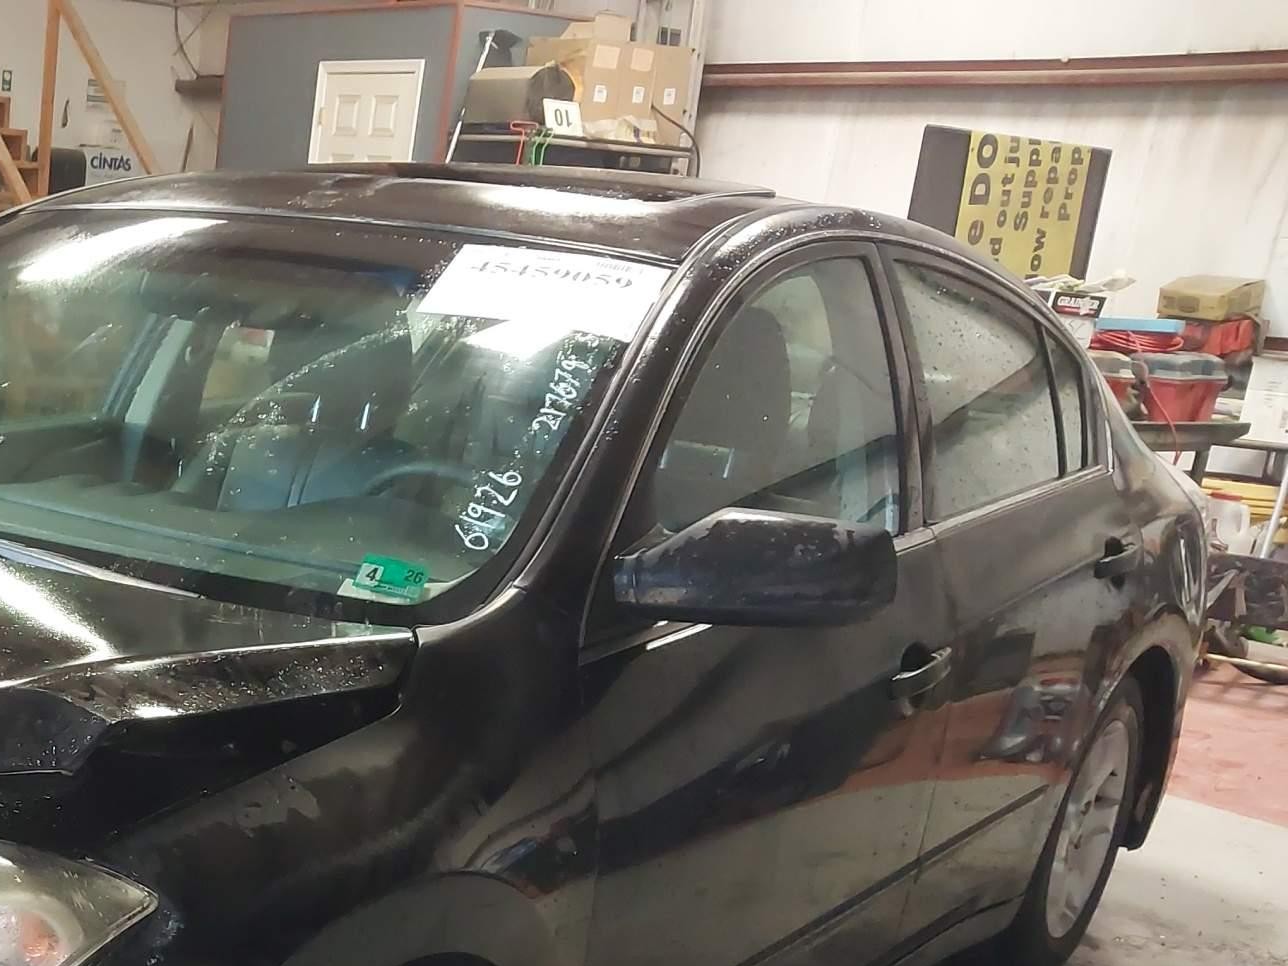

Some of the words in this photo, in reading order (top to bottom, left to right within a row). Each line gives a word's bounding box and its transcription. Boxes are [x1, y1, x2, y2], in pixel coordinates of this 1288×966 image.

[554, 108, 573, 128] 10
[90, 152, 132, 171] CINTAS
[1040, 141, 1062, 219] repa
[996, 173, 1015, 228] out
[1057, 146, 1084, 221] Prop
[365, 567, 379, 581] 4
